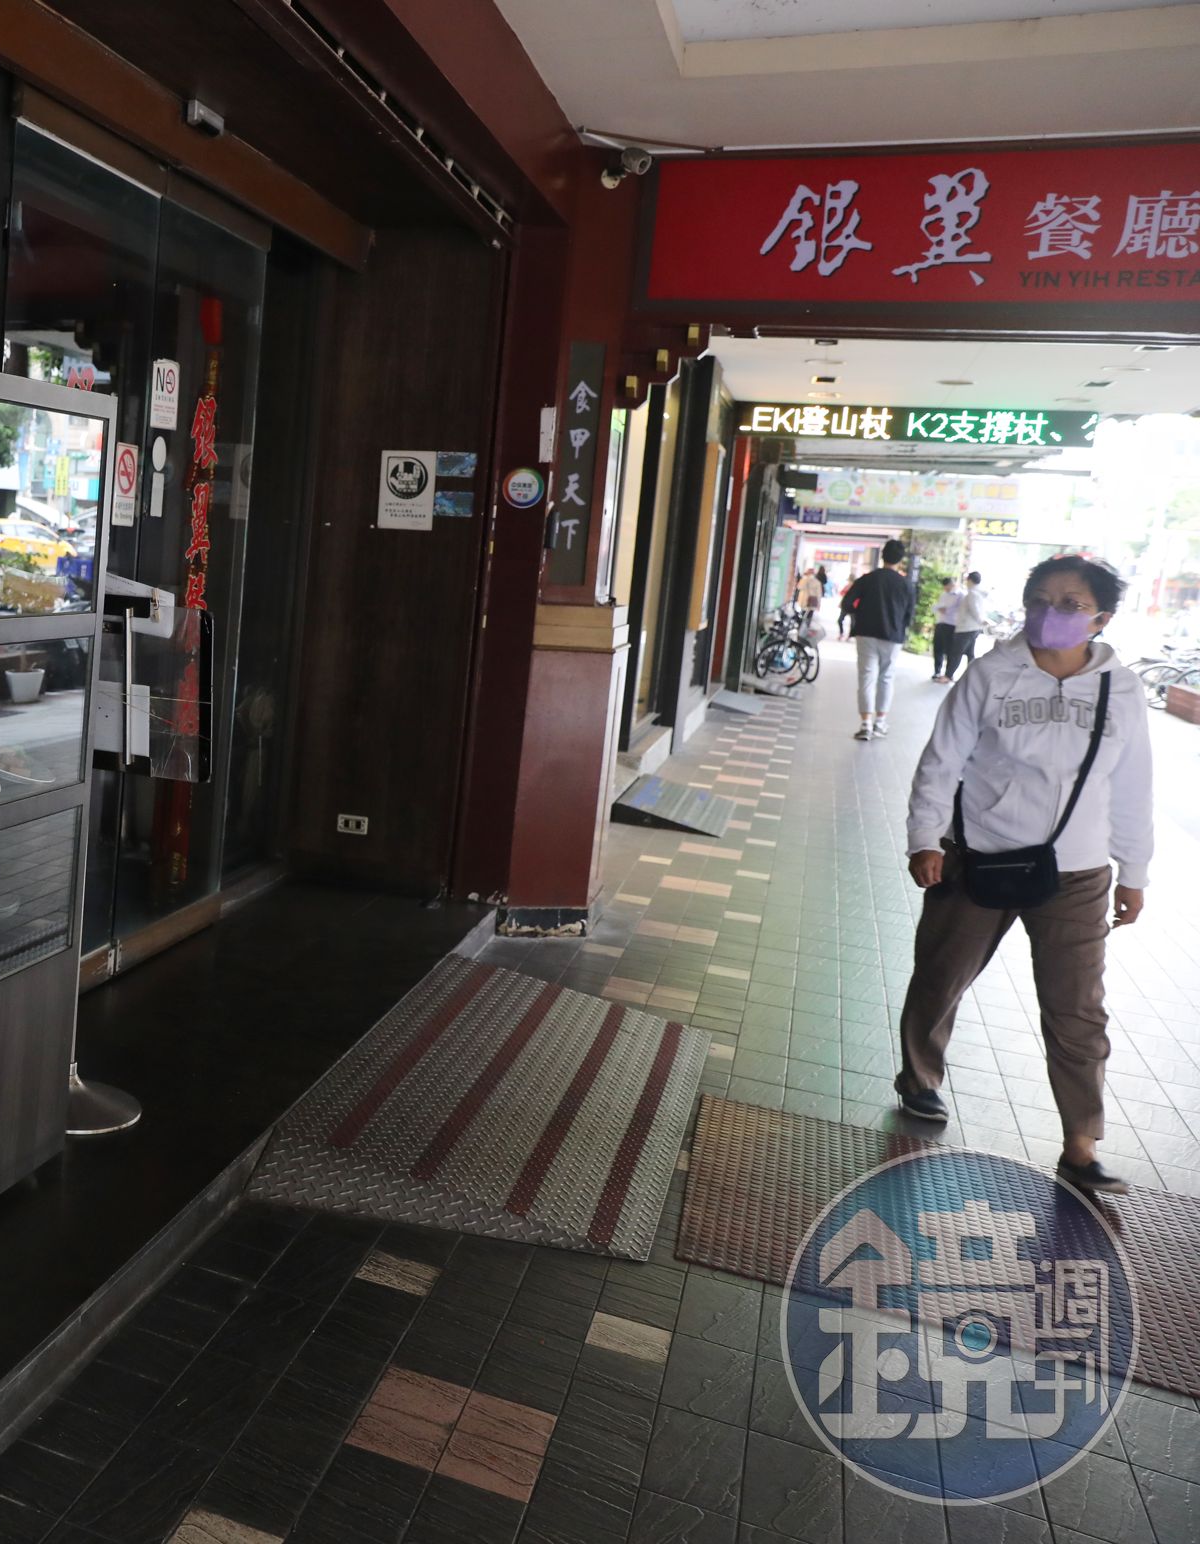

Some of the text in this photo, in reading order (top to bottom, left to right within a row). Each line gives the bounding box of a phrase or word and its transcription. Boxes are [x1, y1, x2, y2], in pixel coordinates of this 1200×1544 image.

[1019, 271, 1061, 288] YIN
[1068, 271, 1109, 288] YIH
[561, 380, 598, 550] 食甲天下
